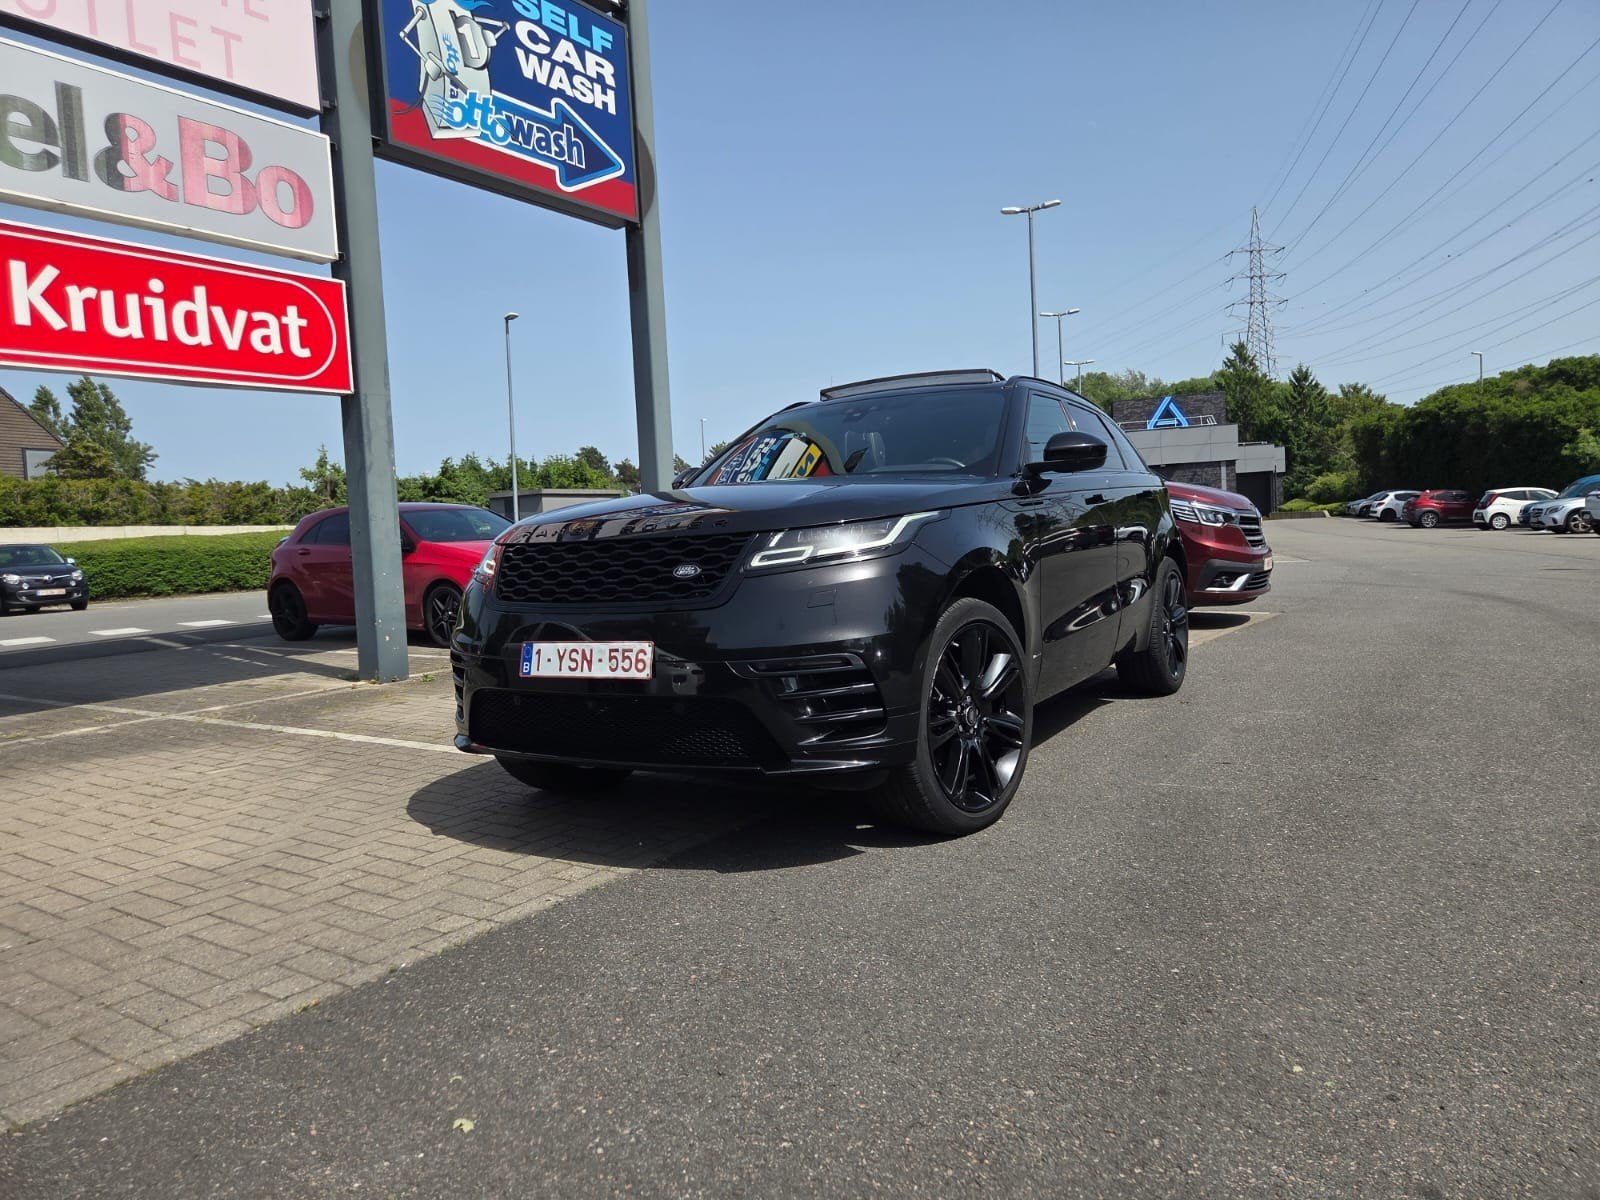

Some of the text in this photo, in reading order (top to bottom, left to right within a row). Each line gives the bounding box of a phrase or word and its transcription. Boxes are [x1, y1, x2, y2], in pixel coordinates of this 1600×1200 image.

[458, 23, 480, 59] 1
[512, 0, 613, 53] SELF
[515, 20, 616, 88] CAR
[514, 46, 616, 115] WASH
[445, 89, 586, 169] ottowash
[8, 259, 312, 358] Kruidvat
[522, 662, 530, 672] B
